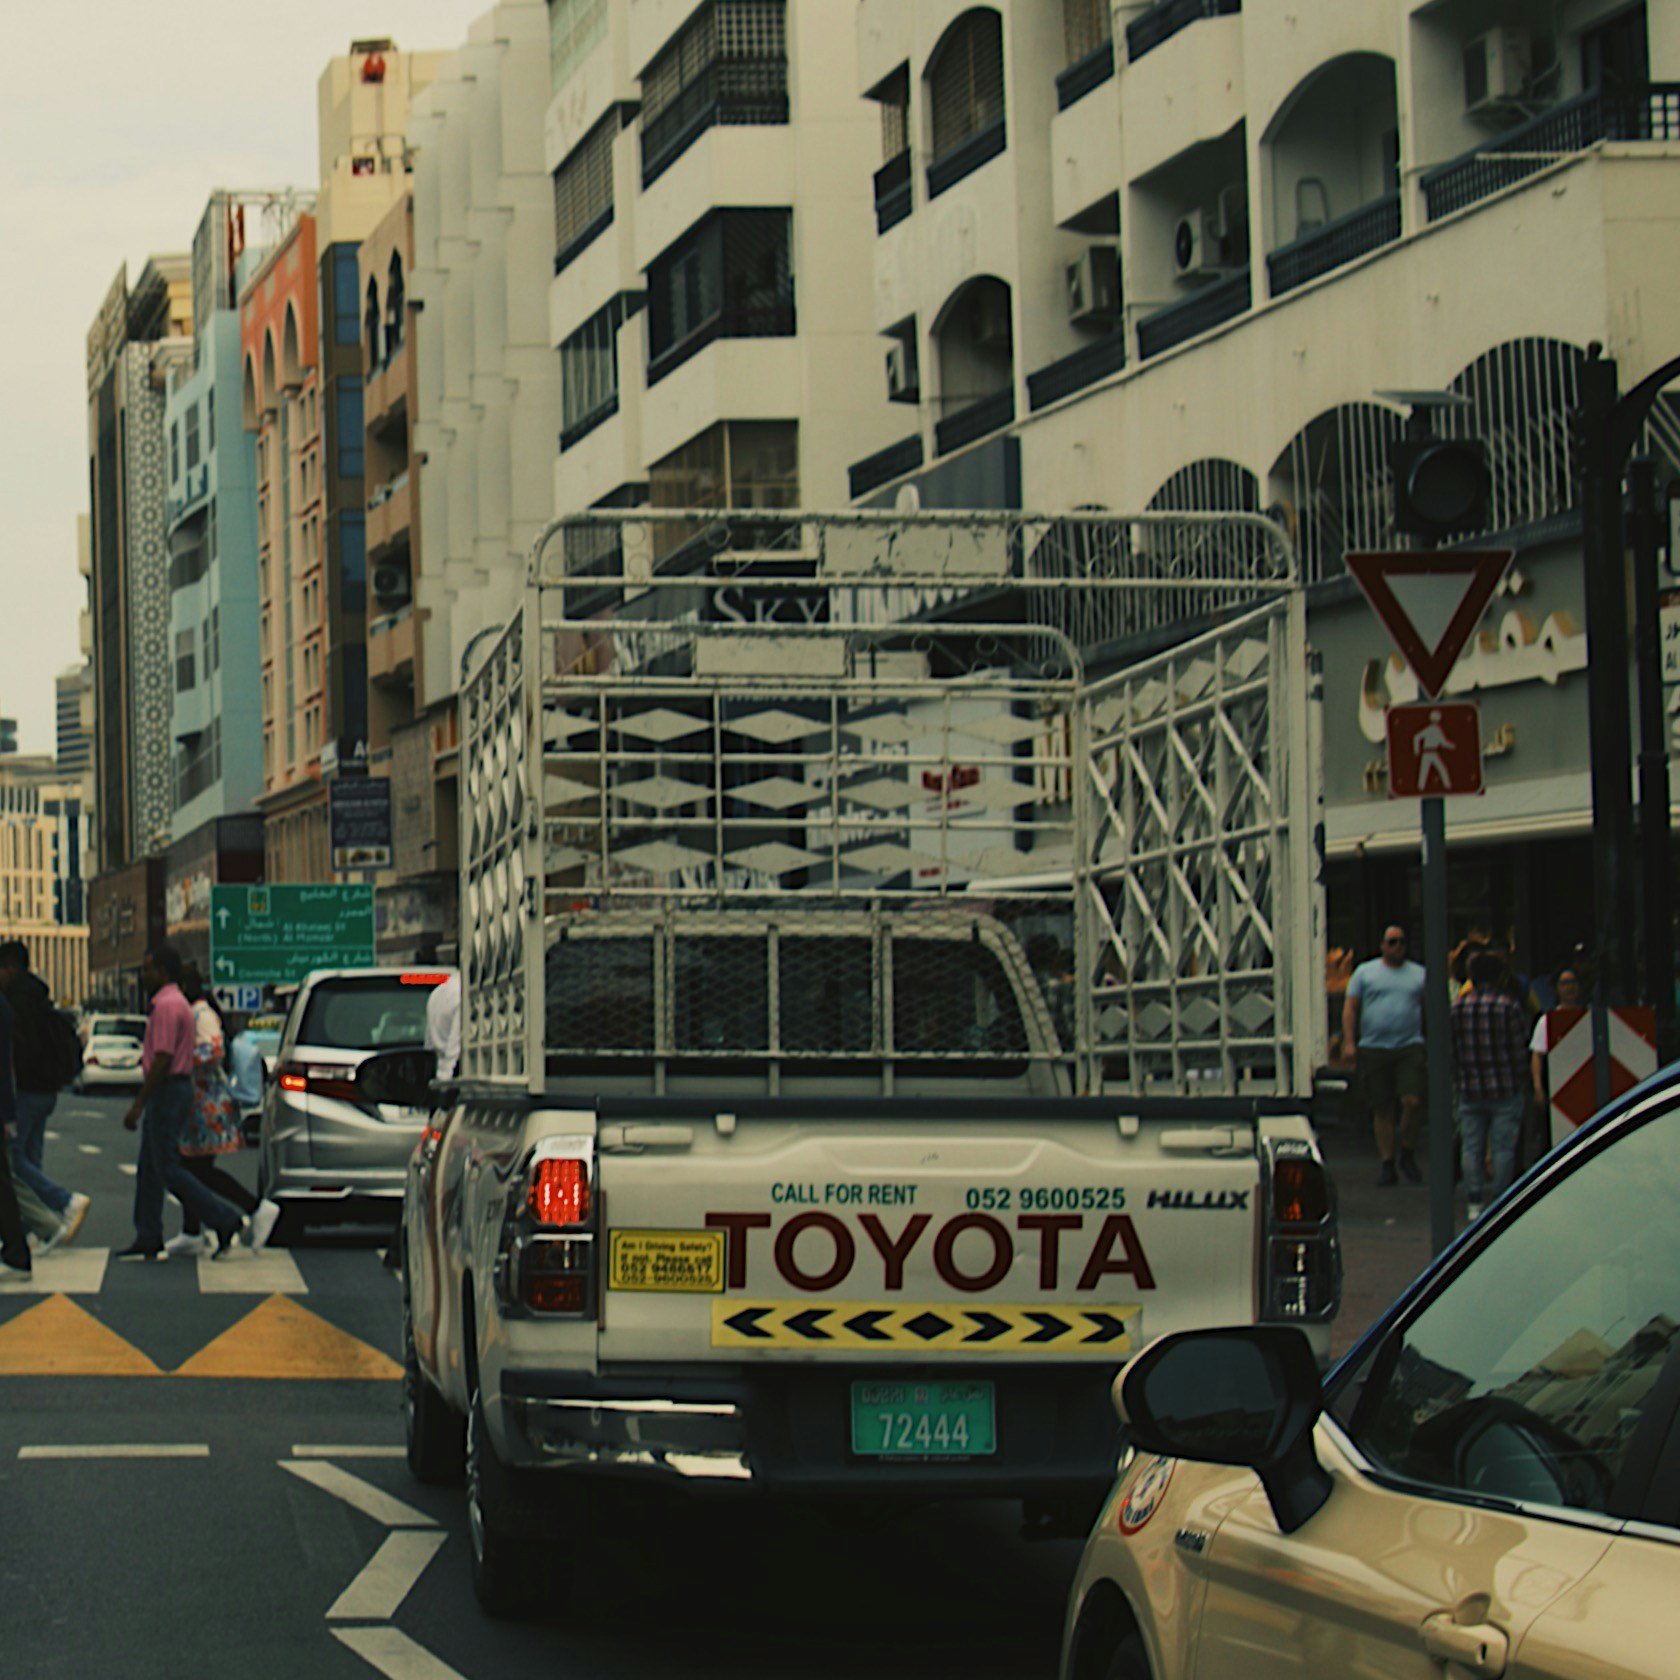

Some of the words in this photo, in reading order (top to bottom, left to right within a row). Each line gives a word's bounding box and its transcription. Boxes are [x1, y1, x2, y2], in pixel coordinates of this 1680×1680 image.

[771, 1183, 820, 1204] CALL
[825, 1184, 863, 1205] FOR
[868, 1184, 918, 1206] RENT
[966, 1187, 1011, 1210] 052
[1019, 1187, 1126, 1211] 9600525
[1147, 1189, 1251, 1210] HILUX
[704, 1210, 1157, 1293] TOYOTA
[879, 1412, 970, 1450] 72444
